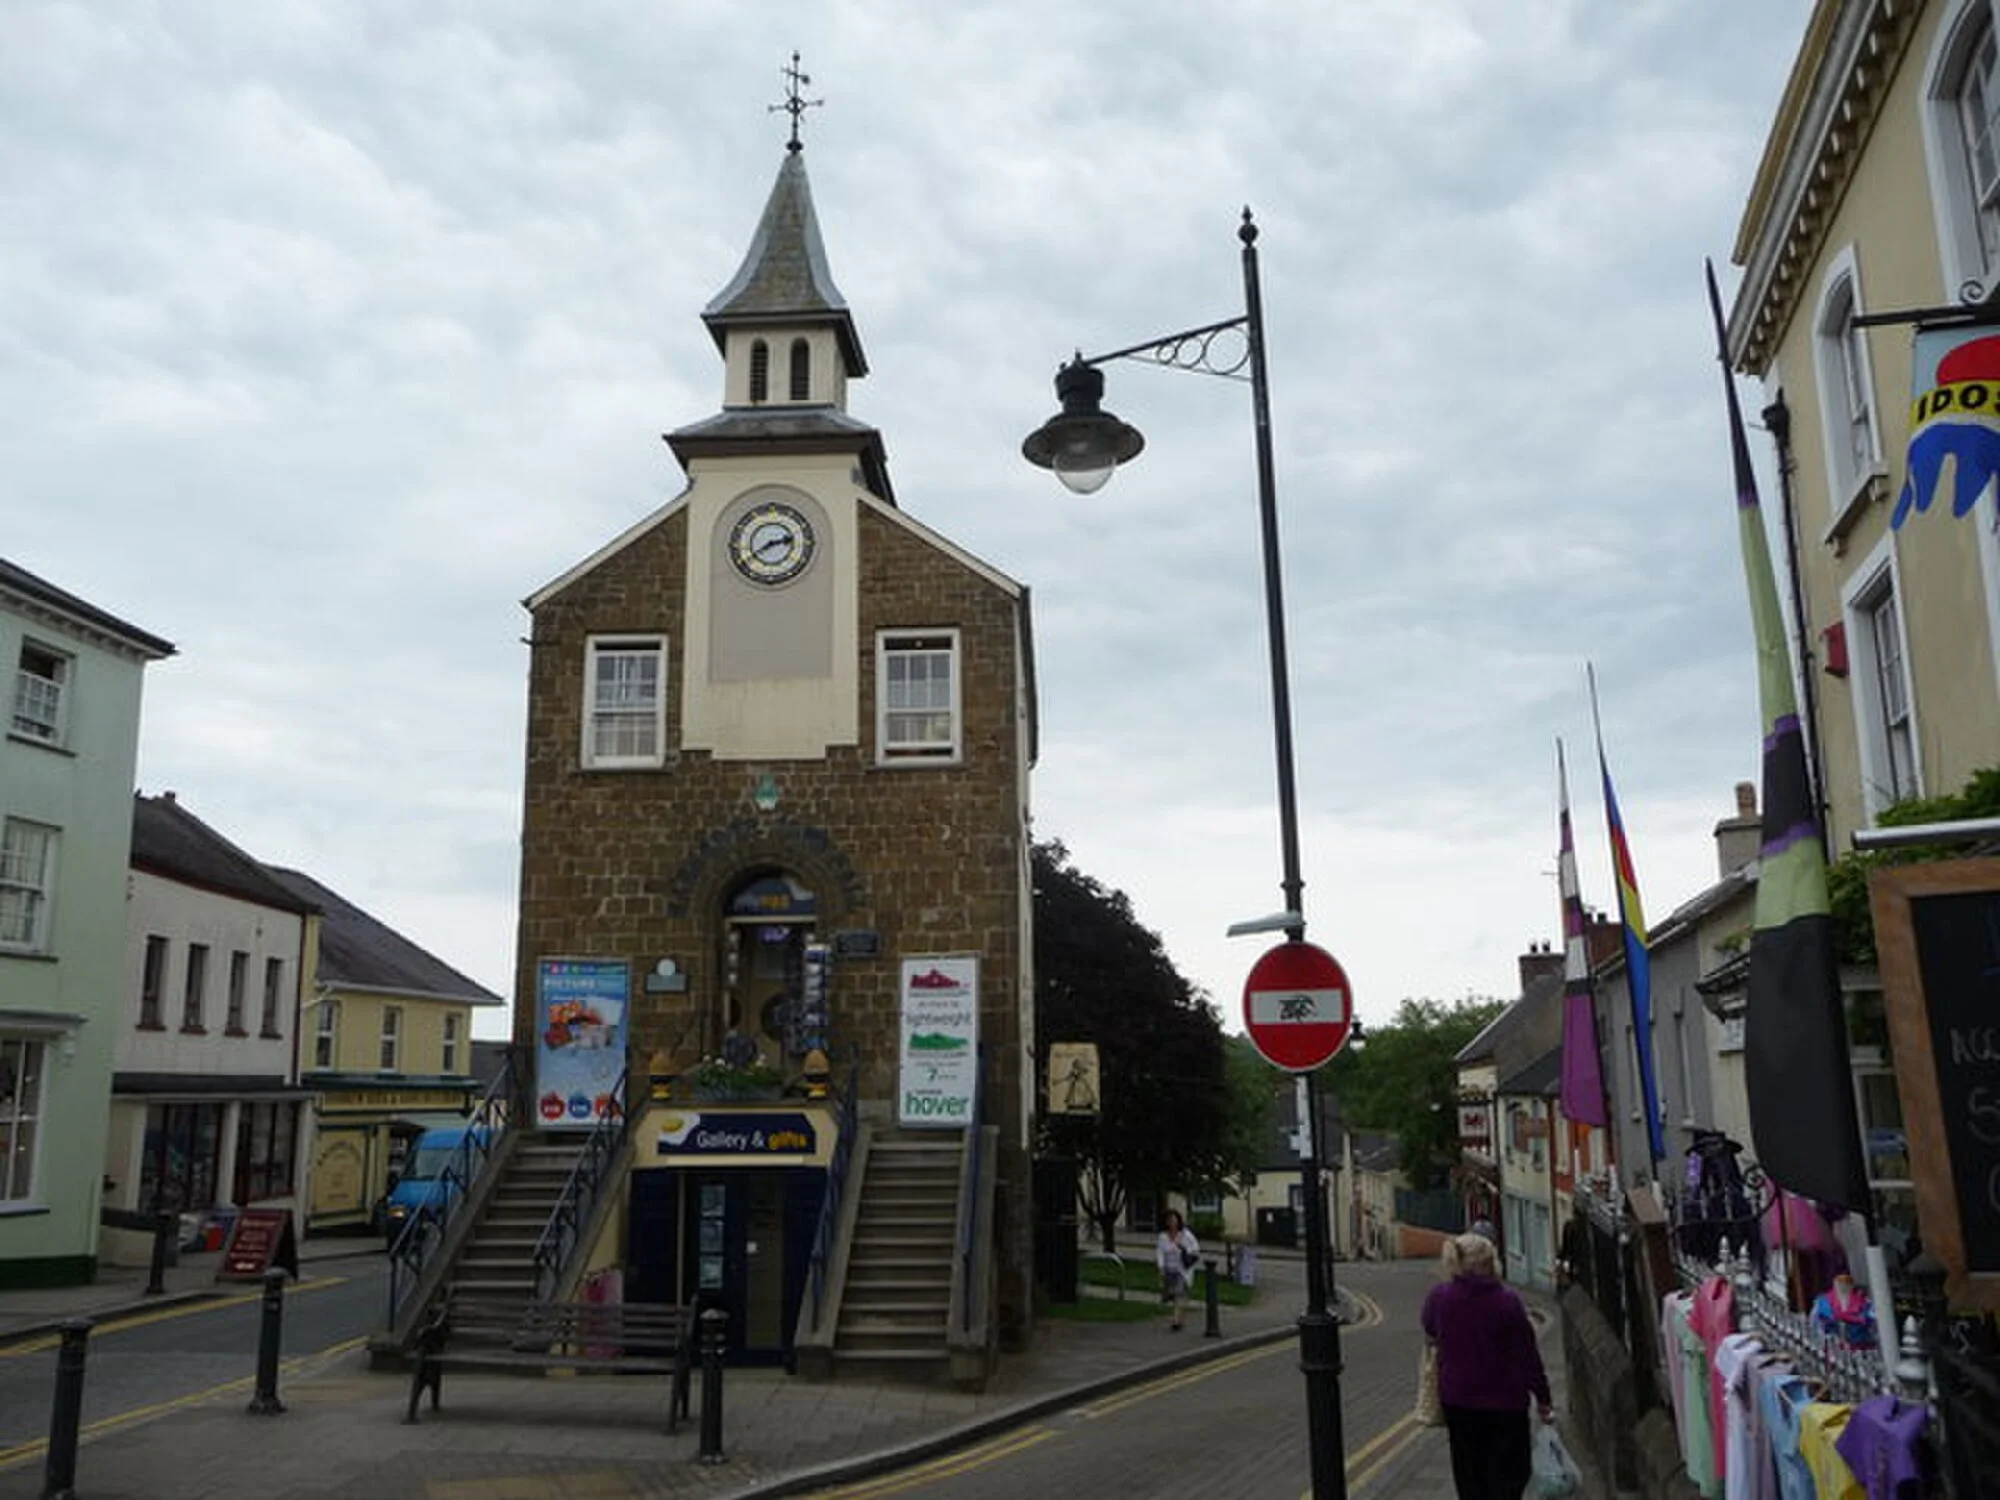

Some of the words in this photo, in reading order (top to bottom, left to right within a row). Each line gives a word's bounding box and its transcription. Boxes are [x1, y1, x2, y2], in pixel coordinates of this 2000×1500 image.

[905, 1091, 969, 1117] hover
[697, 1130, 747, 1151] Gallery
[751, 1130, 765, 1148] &
[768, 1131, 808, 1150] gifts
